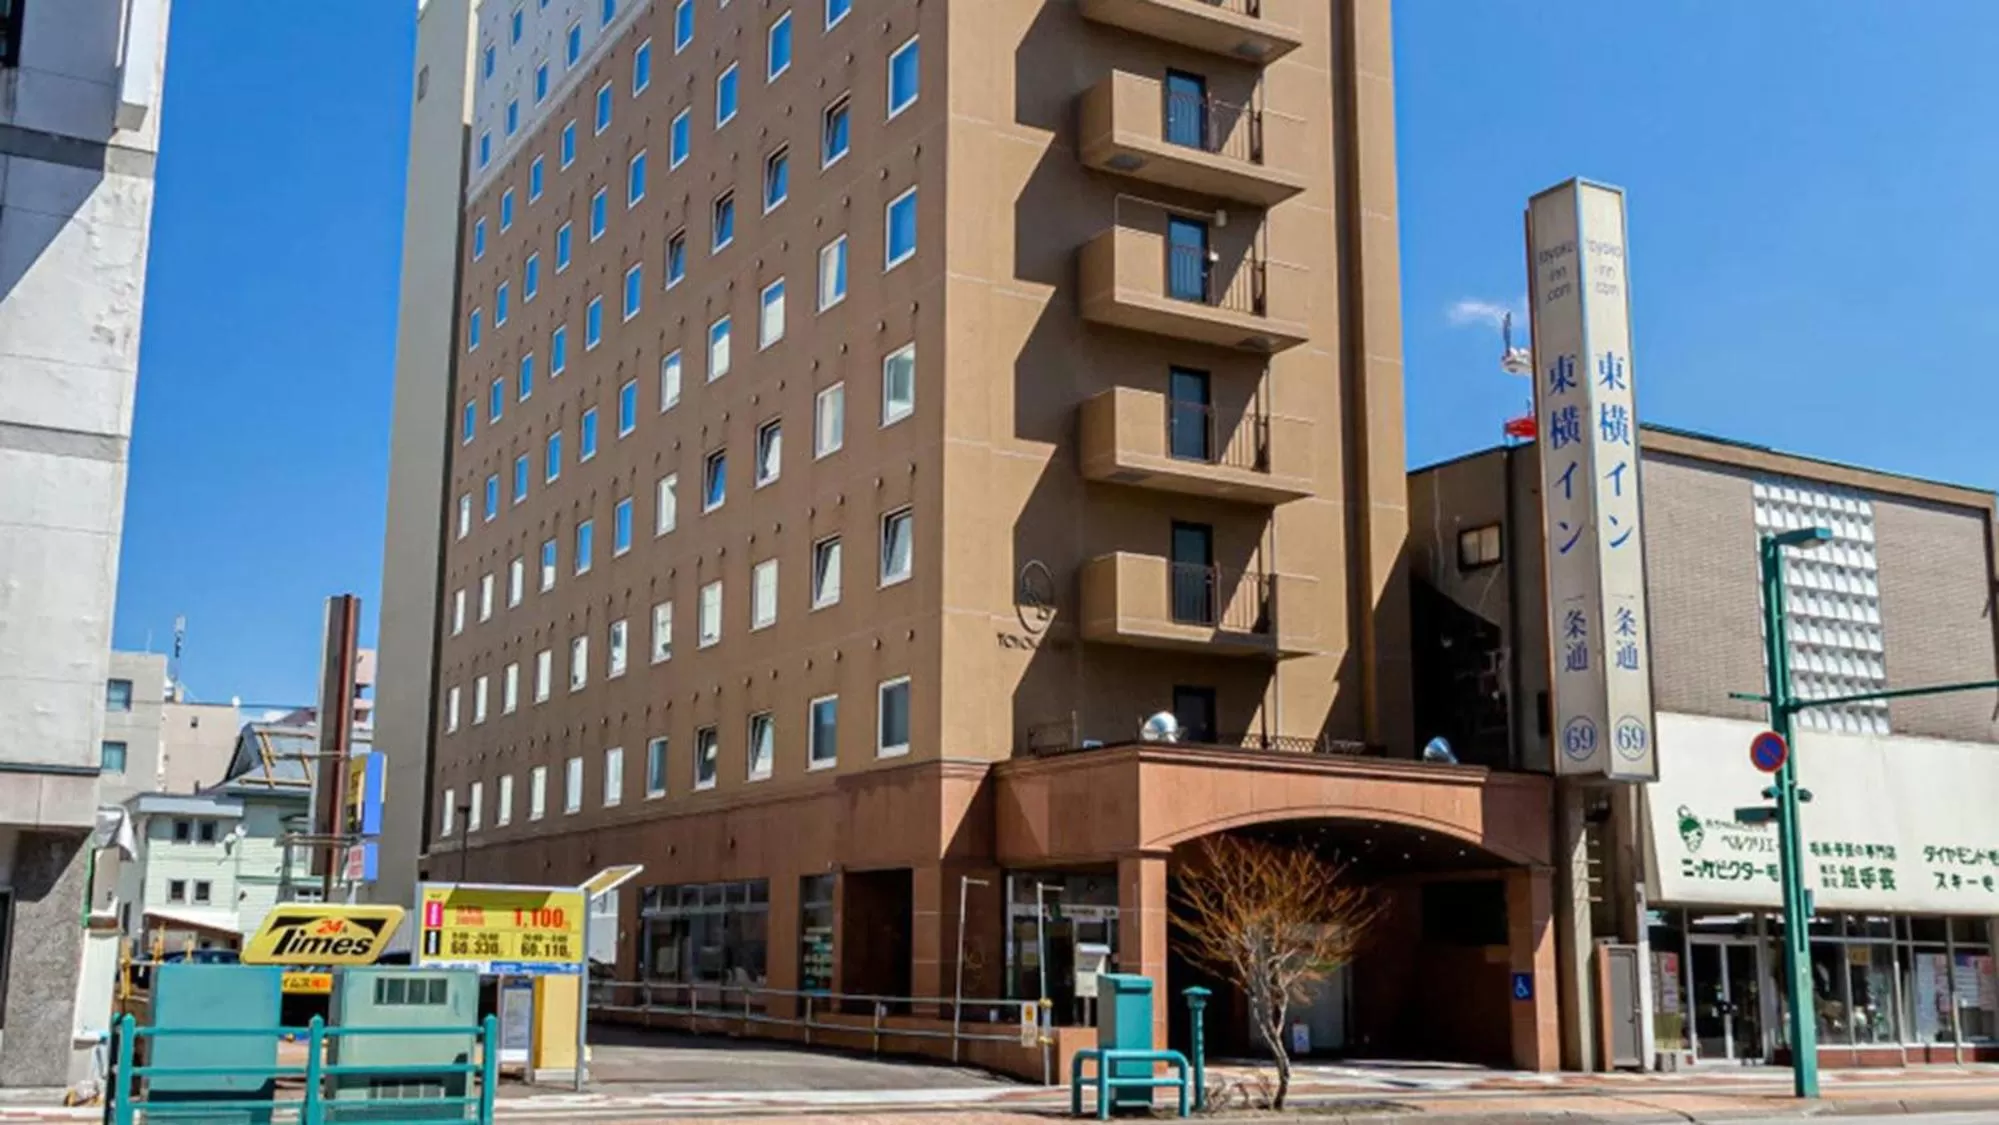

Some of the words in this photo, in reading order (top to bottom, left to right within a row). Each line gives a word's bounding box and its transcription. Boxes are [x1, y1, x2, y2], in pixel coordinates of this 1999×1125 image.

[1550, 355, 1584, 554] 東横イン
[1598, 351, 1633, 548] 東横イン
[1564, 724, 1595, 753] 69
[1617, 724, 1646, 752] 69
[270, 926, 374, 956] Times
